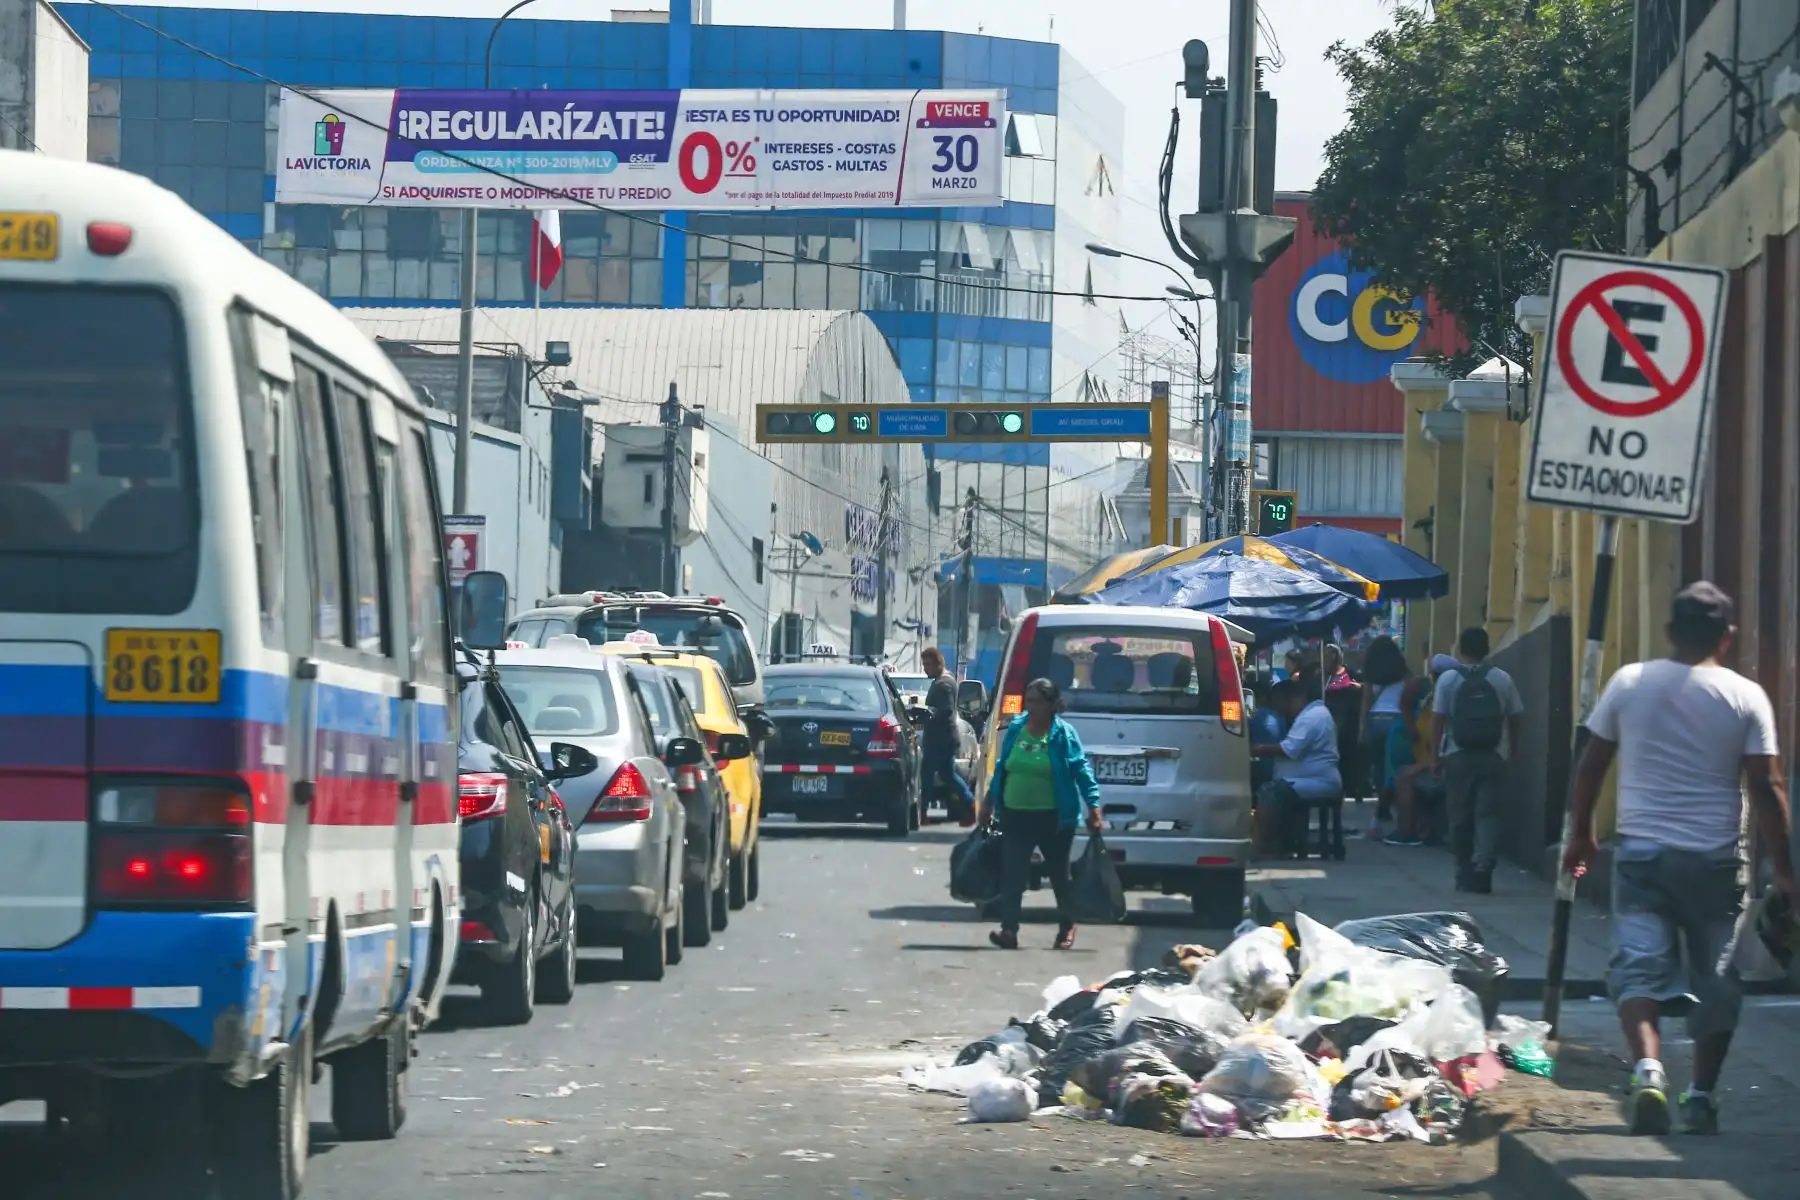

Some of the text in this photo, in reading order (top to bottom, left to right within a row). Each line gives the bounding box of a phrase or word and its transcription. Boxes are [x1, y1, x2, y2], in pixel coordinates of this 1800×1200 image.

[686, 109, 901, 123] ¡ESTA ES TU OPORTUNIDAD!
[934, 104, 981, 118] VENCE
[399, 102, 666, 141] ¡REGULARÍZATE!
[764, 142, 834, 154] INTERESES
[845, 143, 896, 154] COSTAS
[931, 134, 980, 173] 30
[772, 160, 825, 172] GASTOS
[836, 160, 888, 172] MULTAS
[932, 177, 978, 189] MARZO
[383, 186, 672, 200] SI ADQUIRISTE O MODIFICASTE TU PREDIO
[782, 191, 811, 199] totalidad
[812, 191, 821, 199] del
[824, 191, 853, 200] Impuesto
[855, 191, 877, 199] Predial
[878, 191, 894, 199] 2019
[1600, 298, 1667, 388] E
[1588, 425, 1648, 460] NO
[1538, 460, 1686, 505] ESTACIONAR
[1268, 503, 1287, 521] 70
[811, 645, 833, 654] TAXI
[112, 653, 209, 693] 8618
